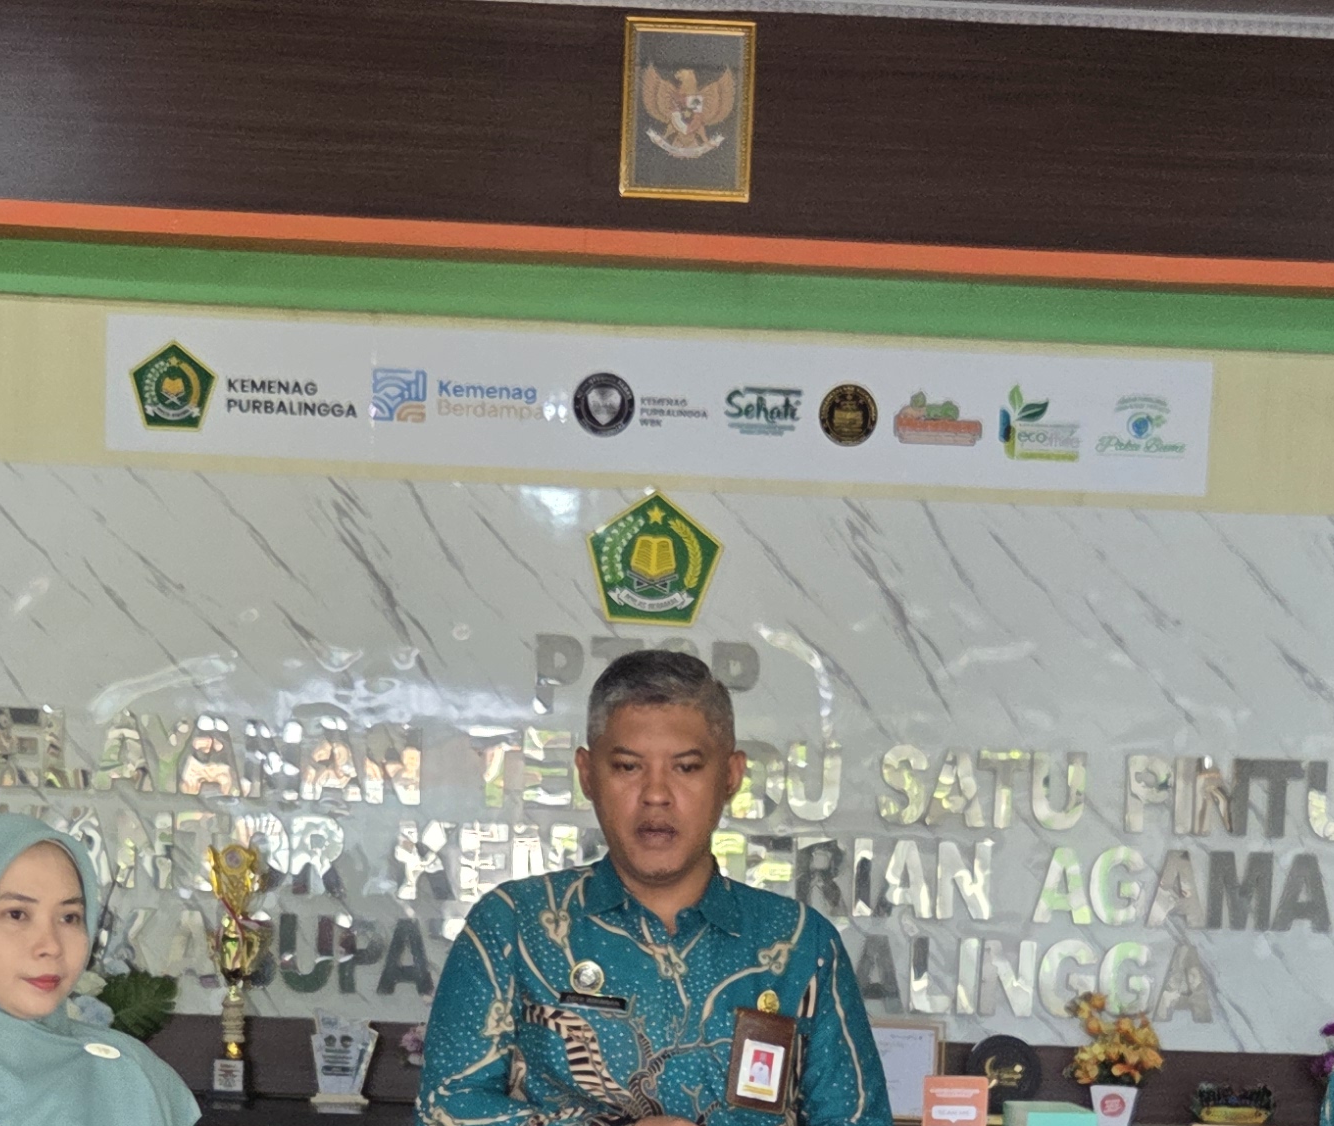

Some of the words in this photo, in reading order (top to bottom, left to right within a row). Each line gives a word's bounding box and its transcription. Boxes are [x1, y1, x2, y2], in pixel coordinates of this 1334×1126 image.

[227, 378, 318, 396] KEMENAG
[437, 379, 537, 405] Kemenag
[226, 399, 357, 418] PURBALINGGA
[640, 397, 688, 407] KEMENAG
[724, 387, 803, 422] Sehati
[640, 408, 708, 419] PURBALINGGA
[877, 743, 1088, 829] SATU
[1033, 845, 1333, 933] AGAMA
